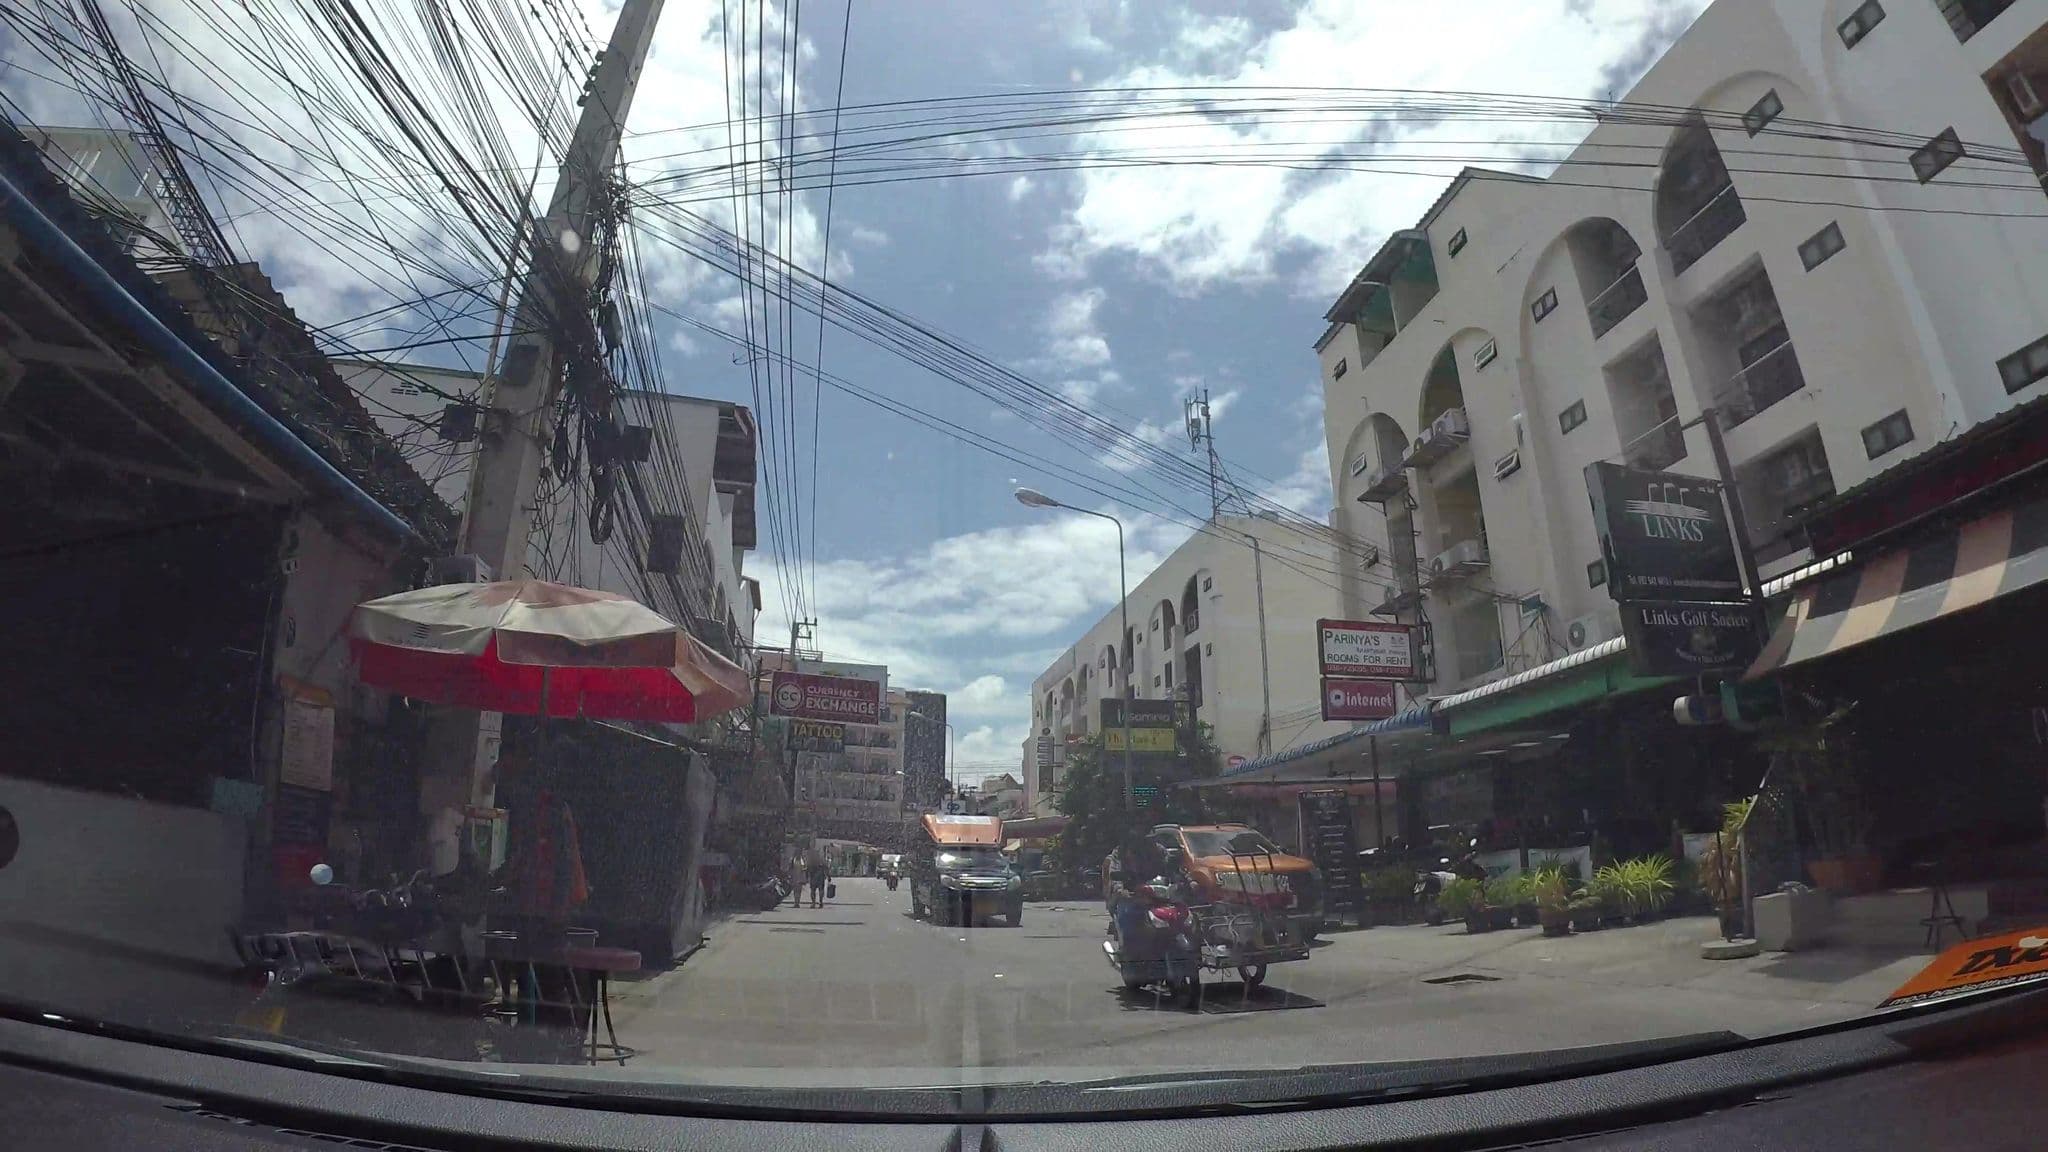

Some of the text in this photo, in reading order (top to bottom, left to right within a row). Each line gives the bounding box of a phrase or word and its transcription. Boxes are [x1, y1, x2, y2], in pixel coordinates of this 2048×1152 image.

[1642, 515, 1704, 542] LINKS
[1642, 609, 1679, 626] Links
[1681, 610, 1707, 626] Golf
[1324, 631, 1380, 646] PARINYA'S
[1327, 653, 1408, 665] ROOMS FOR RENT
[806, 686, 860, 698] CURRENCY
[806, 697, 876, 715] EXCHANGE
[1346, 692, 1392, 708] internet
[793, 723, 843, 738] TATTOO
